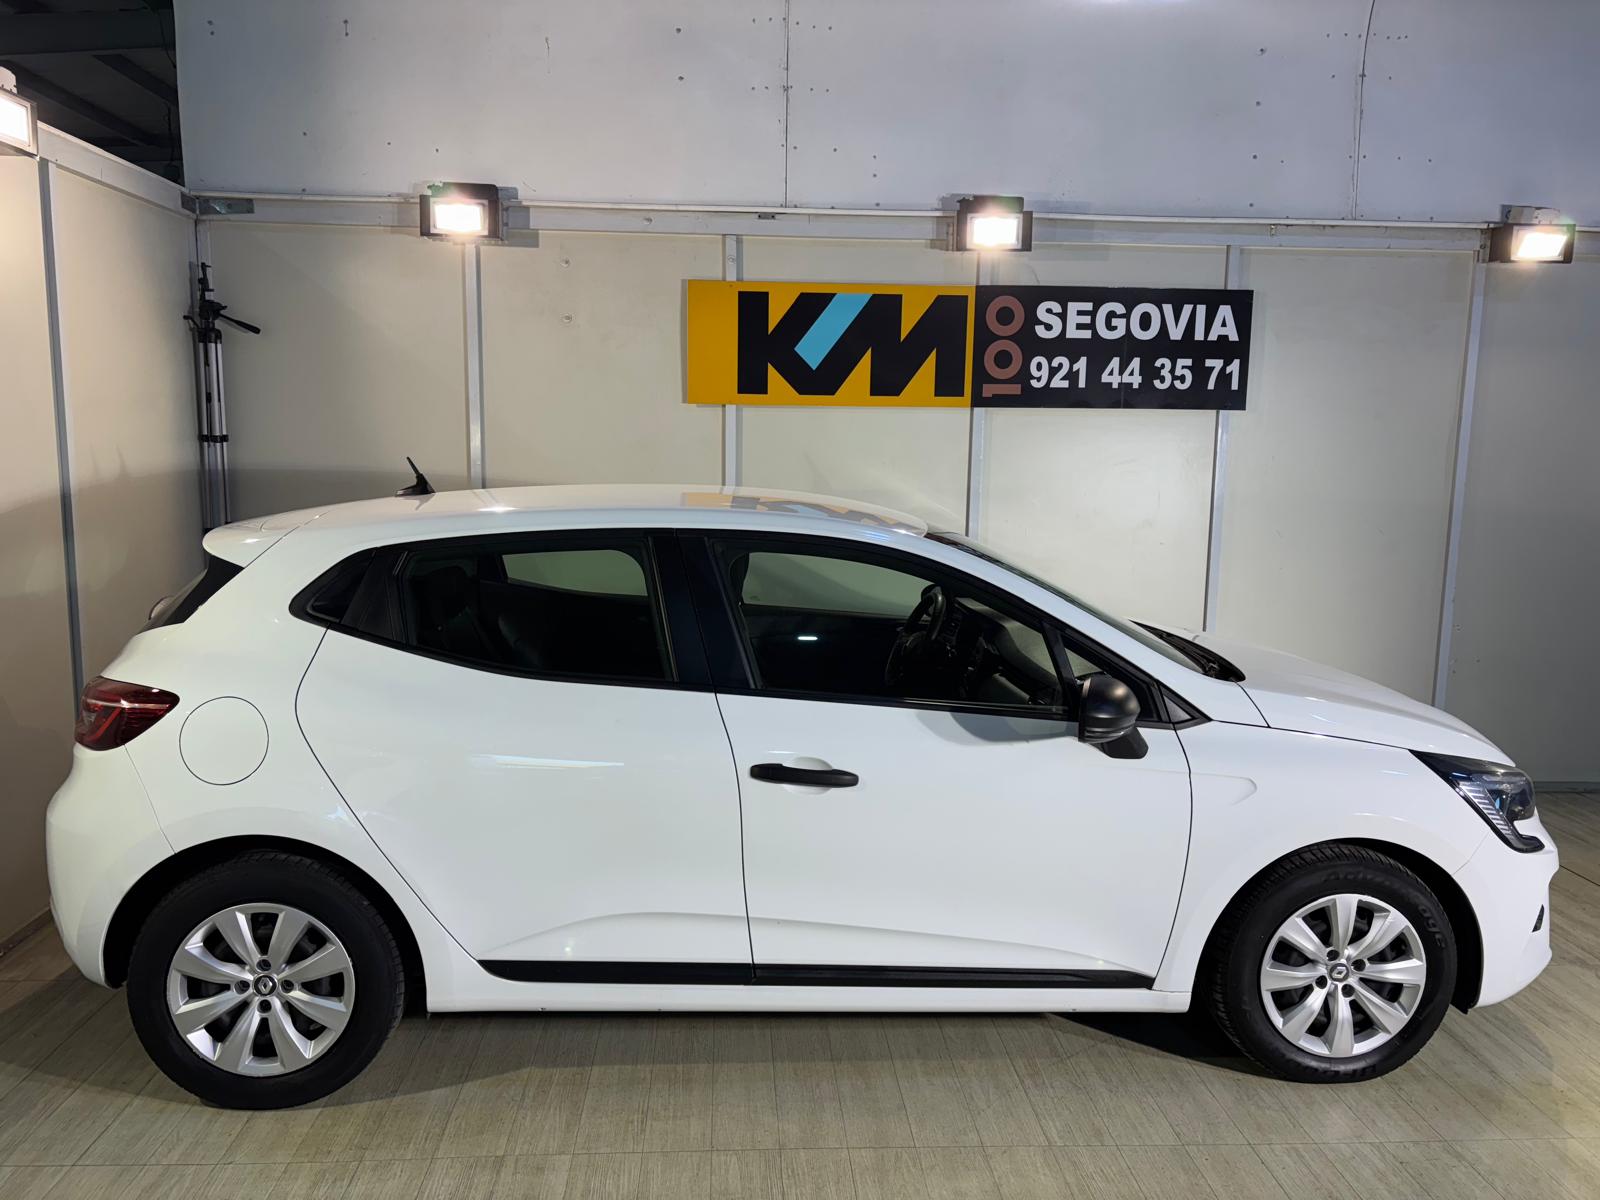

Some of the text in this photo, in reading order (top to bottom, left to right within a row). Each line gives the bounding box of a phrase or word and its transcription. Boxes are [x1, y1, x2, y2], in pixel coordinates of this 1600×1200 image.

[737, 291, 969, 397] KM
[982, 295, 1025, 398] 100
[1034, 300, 1240, 342] SEGOVIA
[1029, 356, 1241, 391] 921 44 35 71
